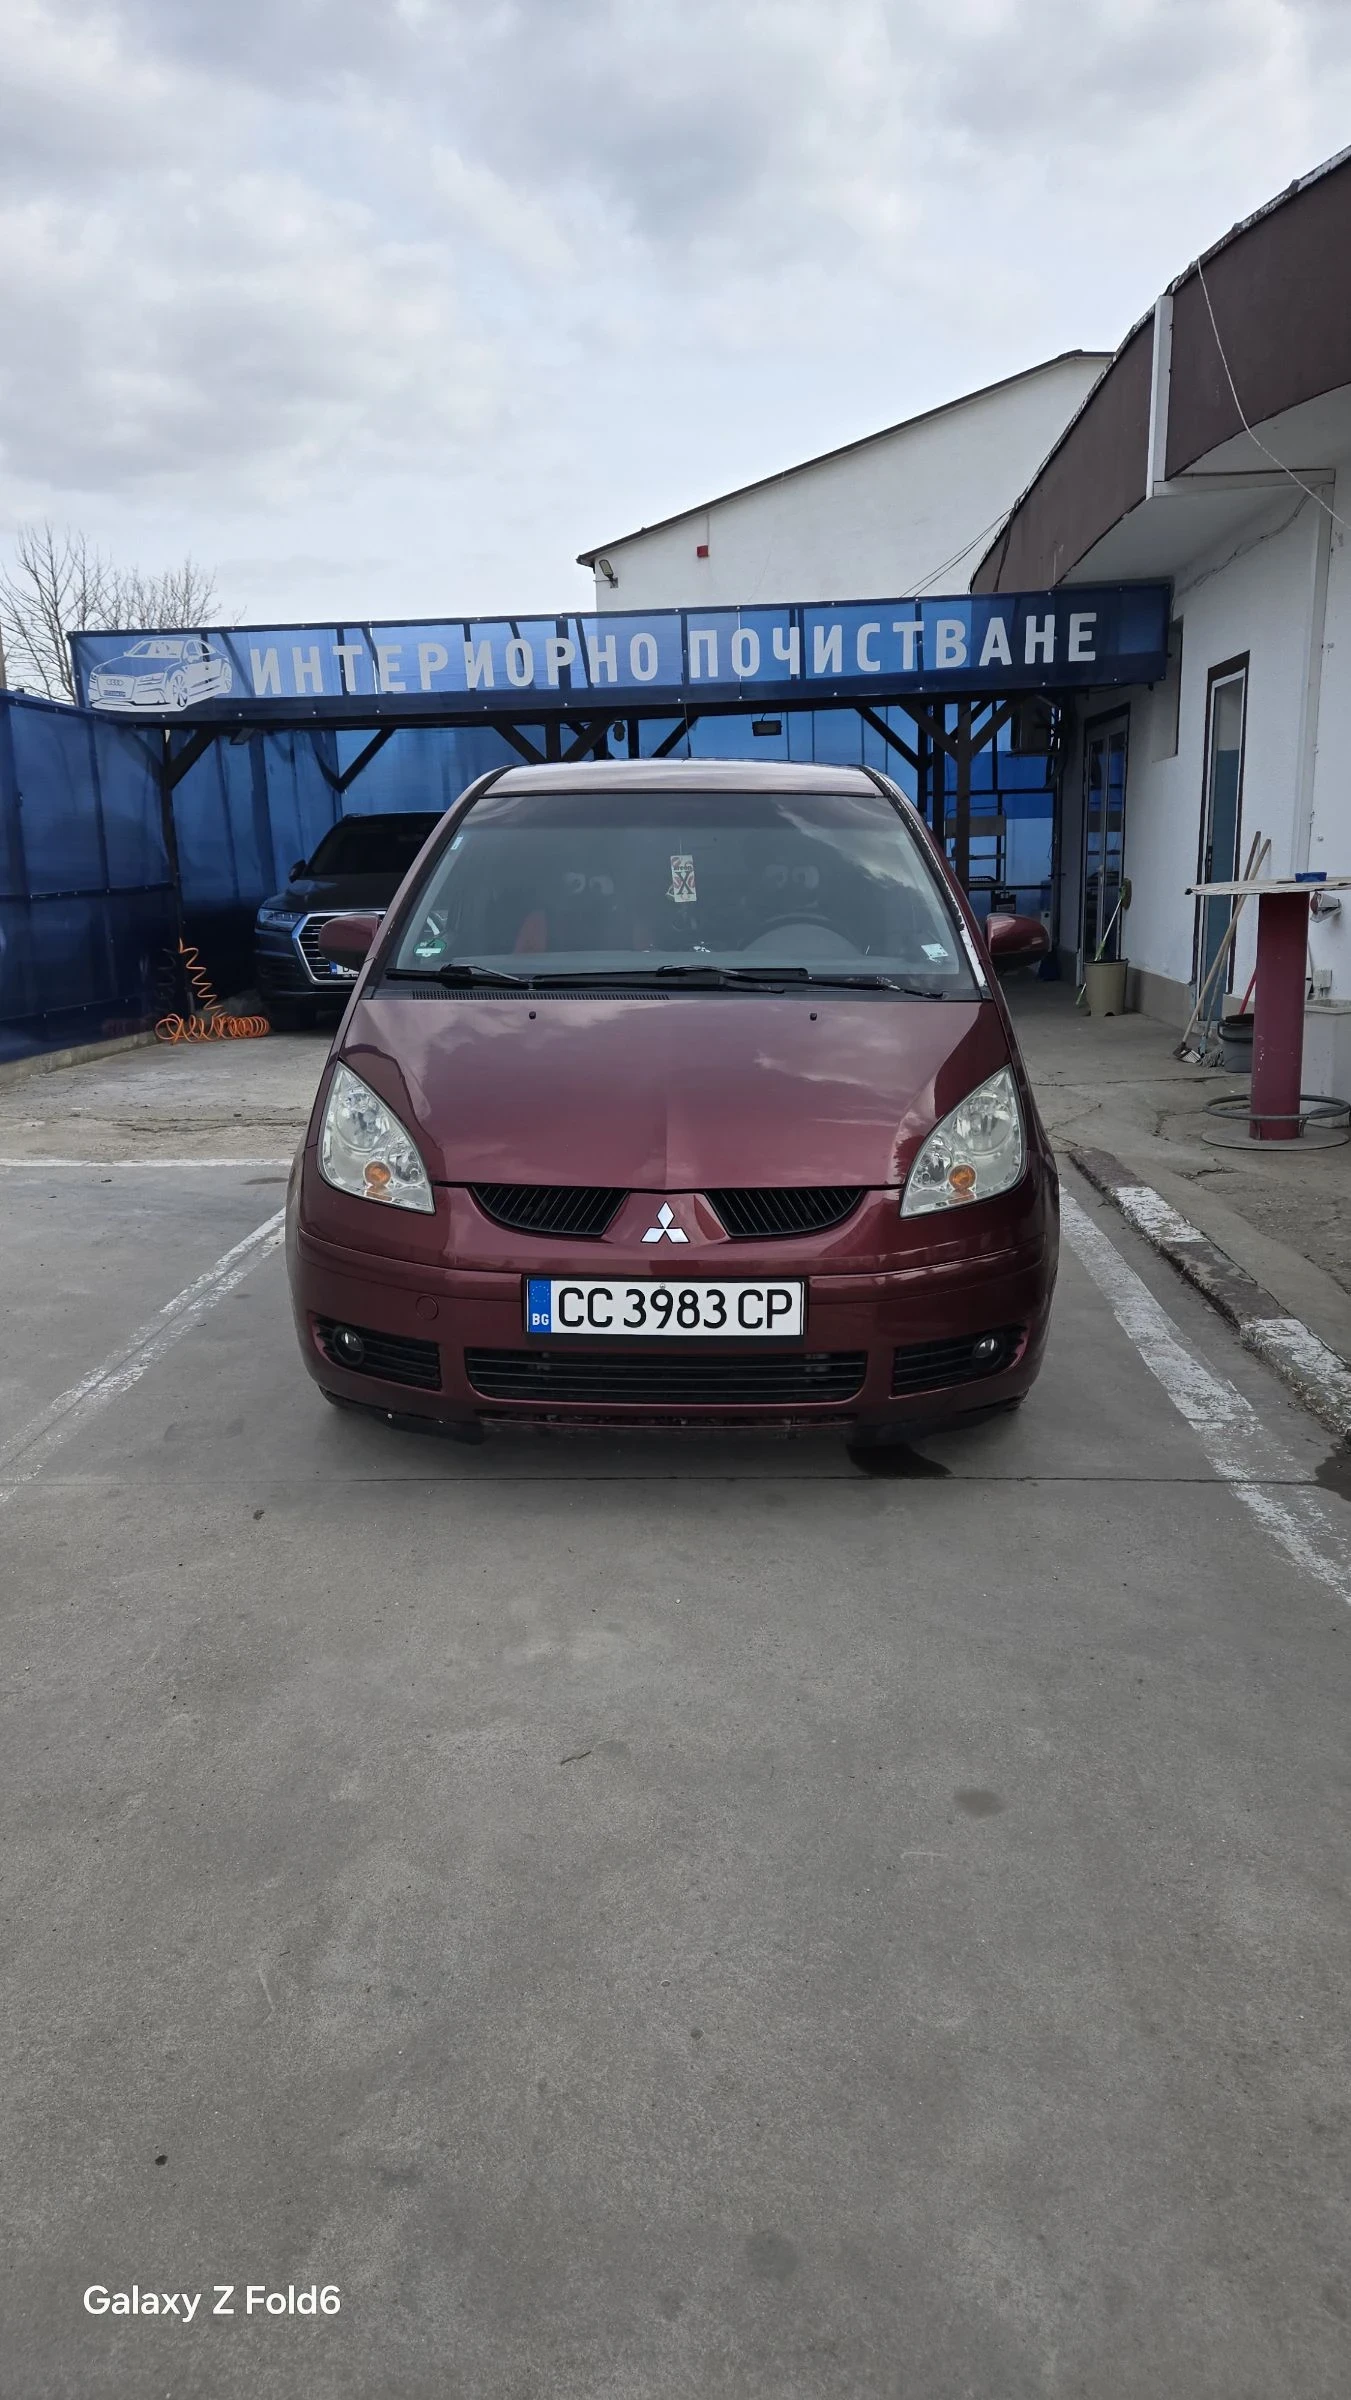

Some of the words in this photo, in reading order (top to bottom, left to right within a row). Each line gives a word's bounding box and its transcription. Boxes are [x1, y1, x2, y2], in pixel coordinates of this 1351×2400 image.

[250, 633, 659, 696] ИНТЕРИОРНО
[689, 612, 1097, 678] ПОЧИСТВАНЕ
[532, 1313, 549, 1326] BG
